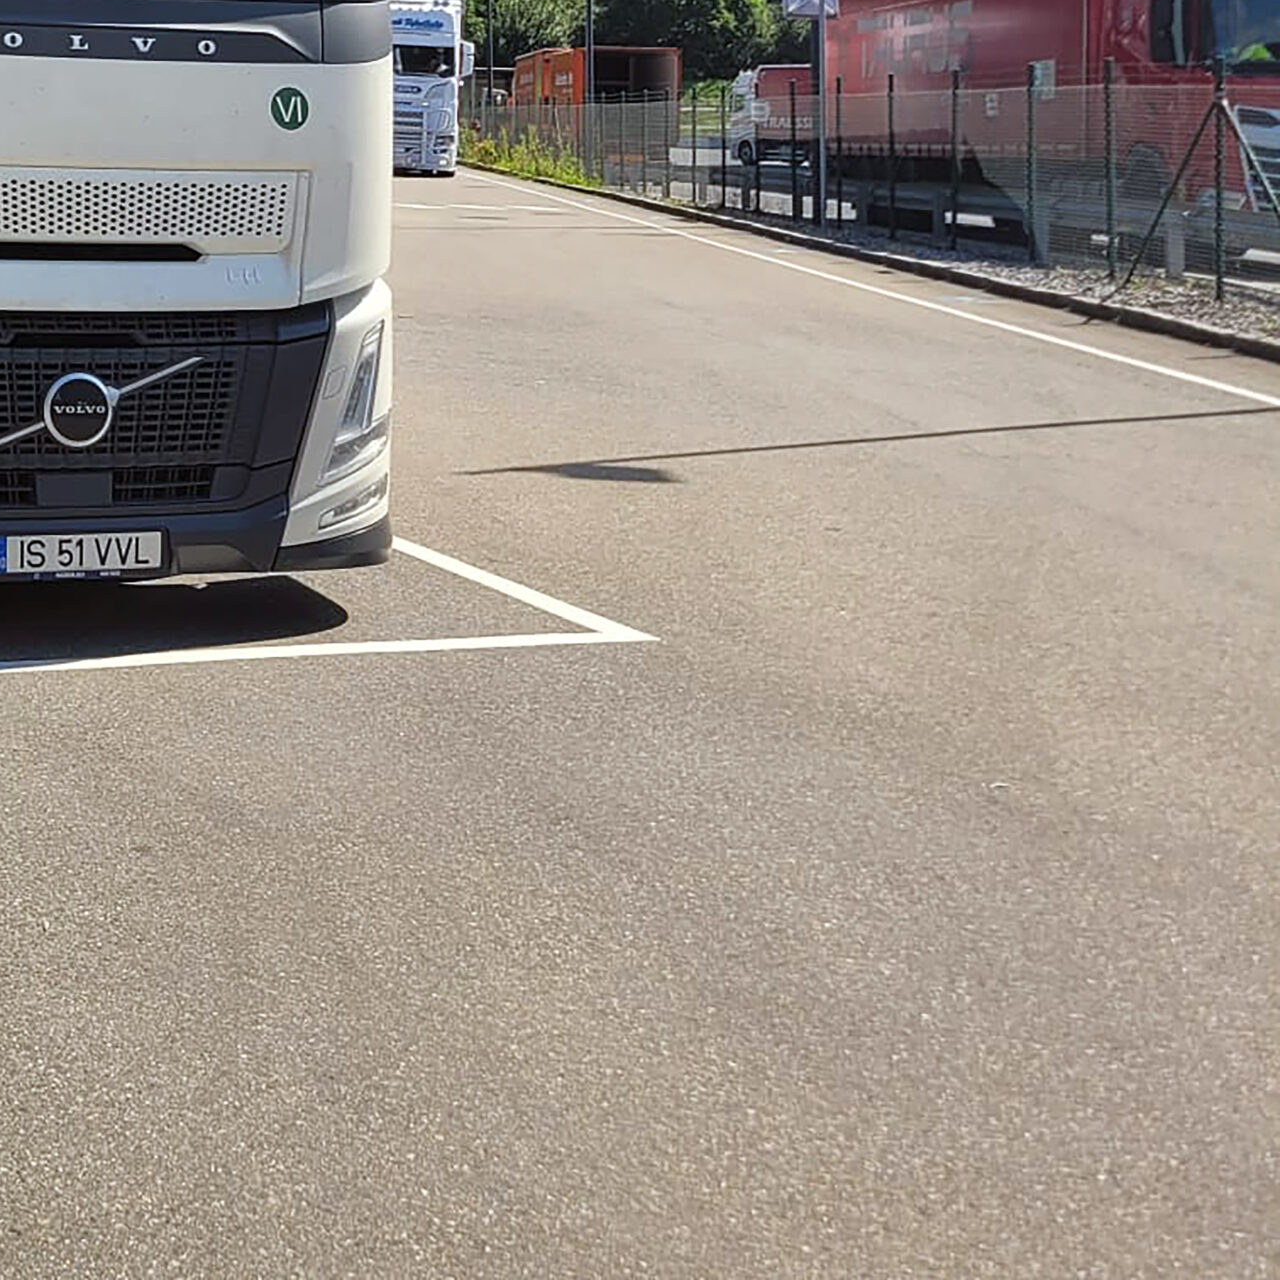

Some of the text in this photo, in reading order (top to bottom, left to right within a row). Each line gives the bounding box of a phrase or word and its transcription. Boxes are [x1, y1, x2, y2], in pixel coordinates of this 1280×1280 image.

[276, 96, 303, 123] VI
[53, 404, 107, 415] VOLVO
[20, 539, 46, 569] IS
[58, 538, 84, 568] 51
[95, 536, 150, 566] VVL
